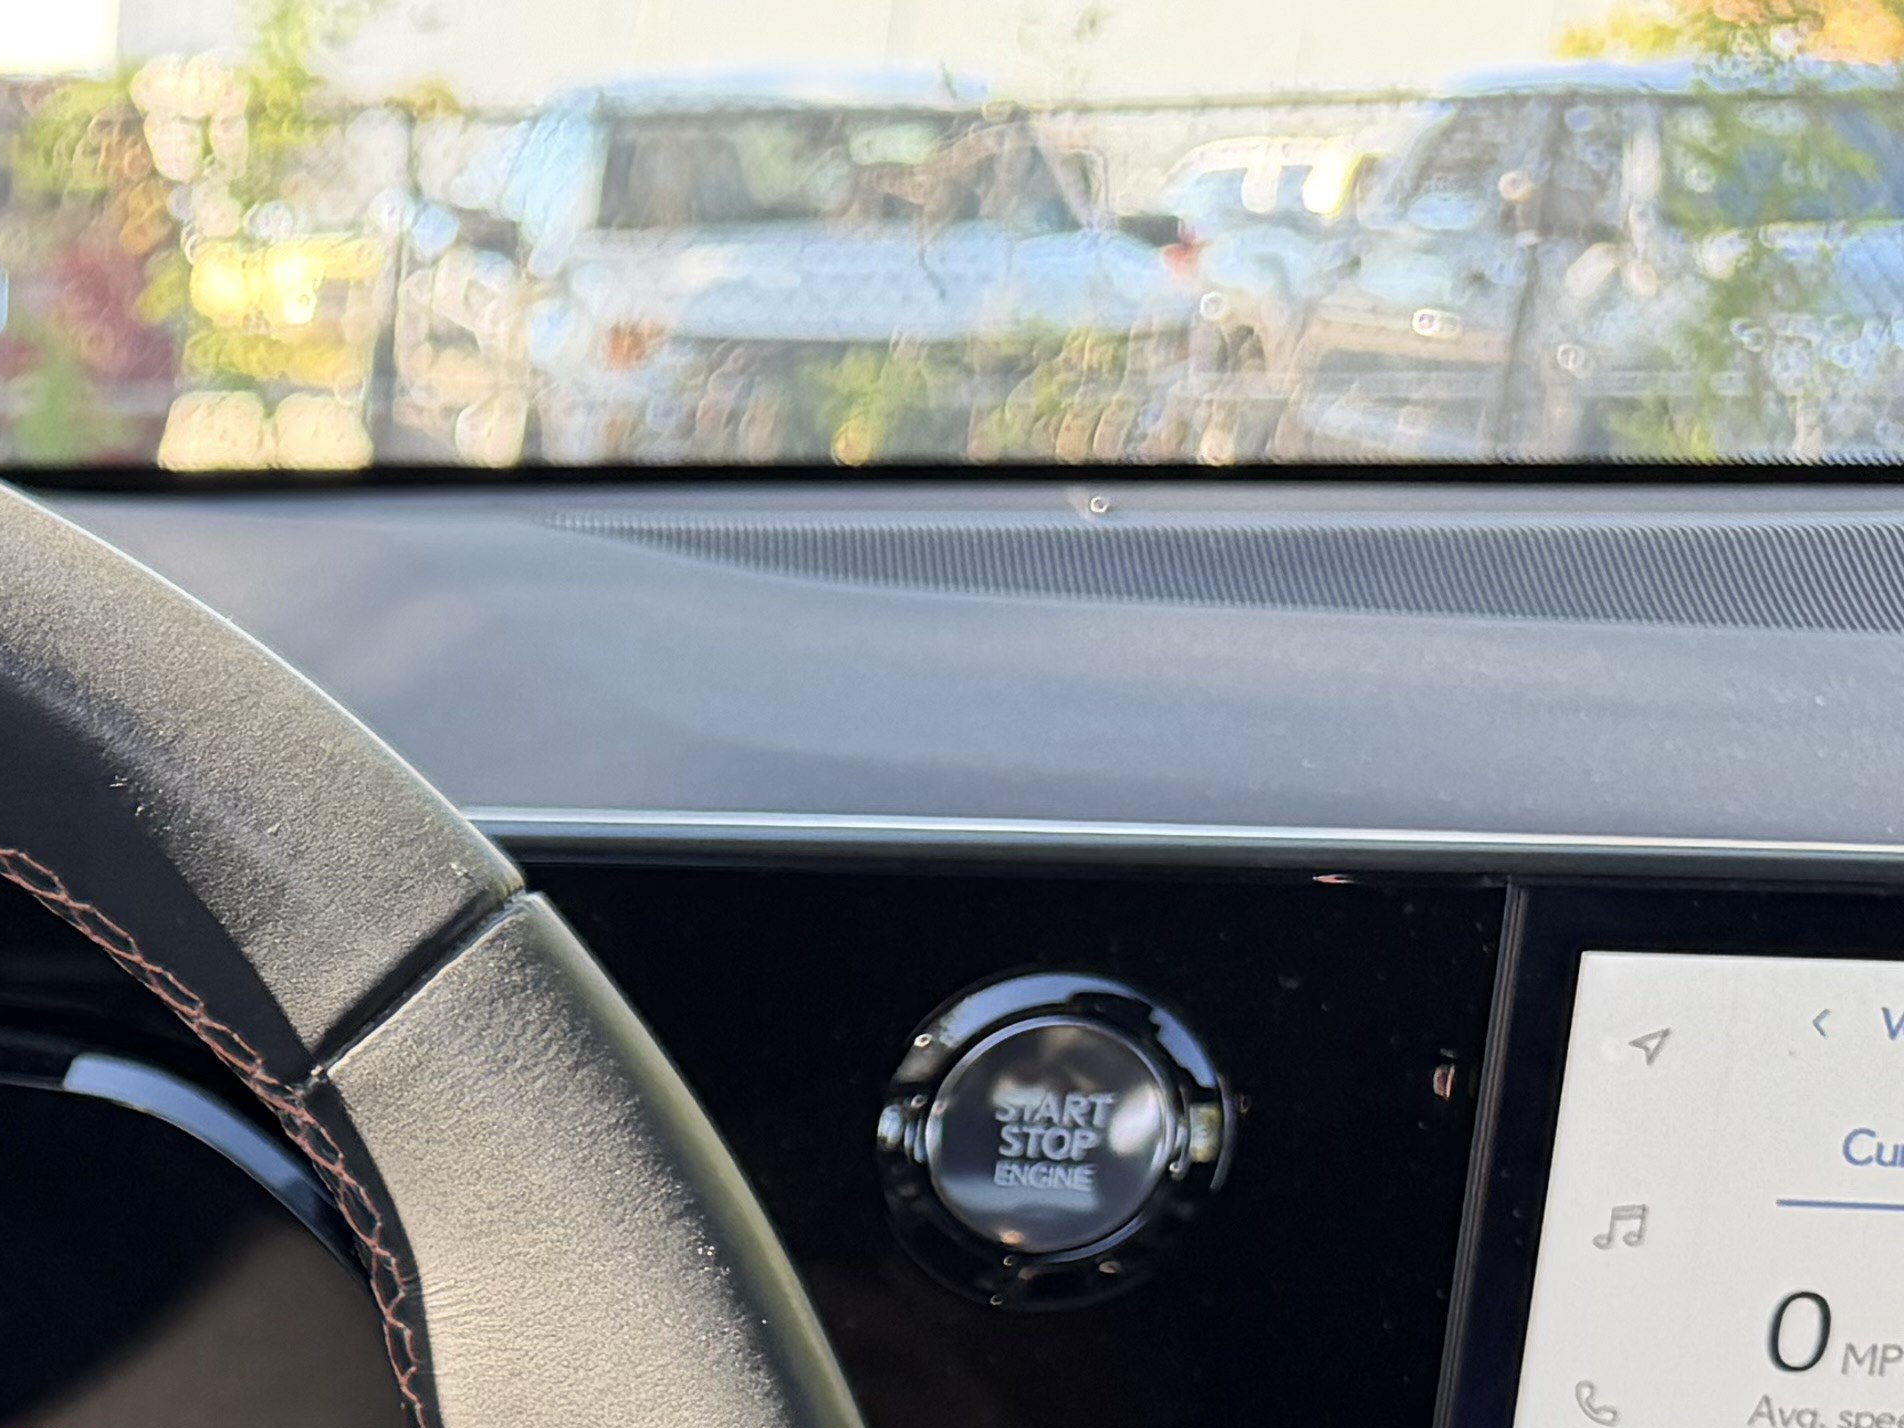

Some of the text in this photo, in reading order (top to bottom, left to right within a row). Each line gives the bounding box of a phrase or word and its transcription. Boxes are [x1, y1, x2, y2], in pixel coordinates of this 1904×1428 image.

[994, 1091, 1116, 1128] START
[999, 1125, 1099, 1161] STOP
[1842, 1127, 1904, 1168] Cu
[993, 1160, 1097, 1191] ENGINE
[1767, 1290, 1832, 1373] 0
